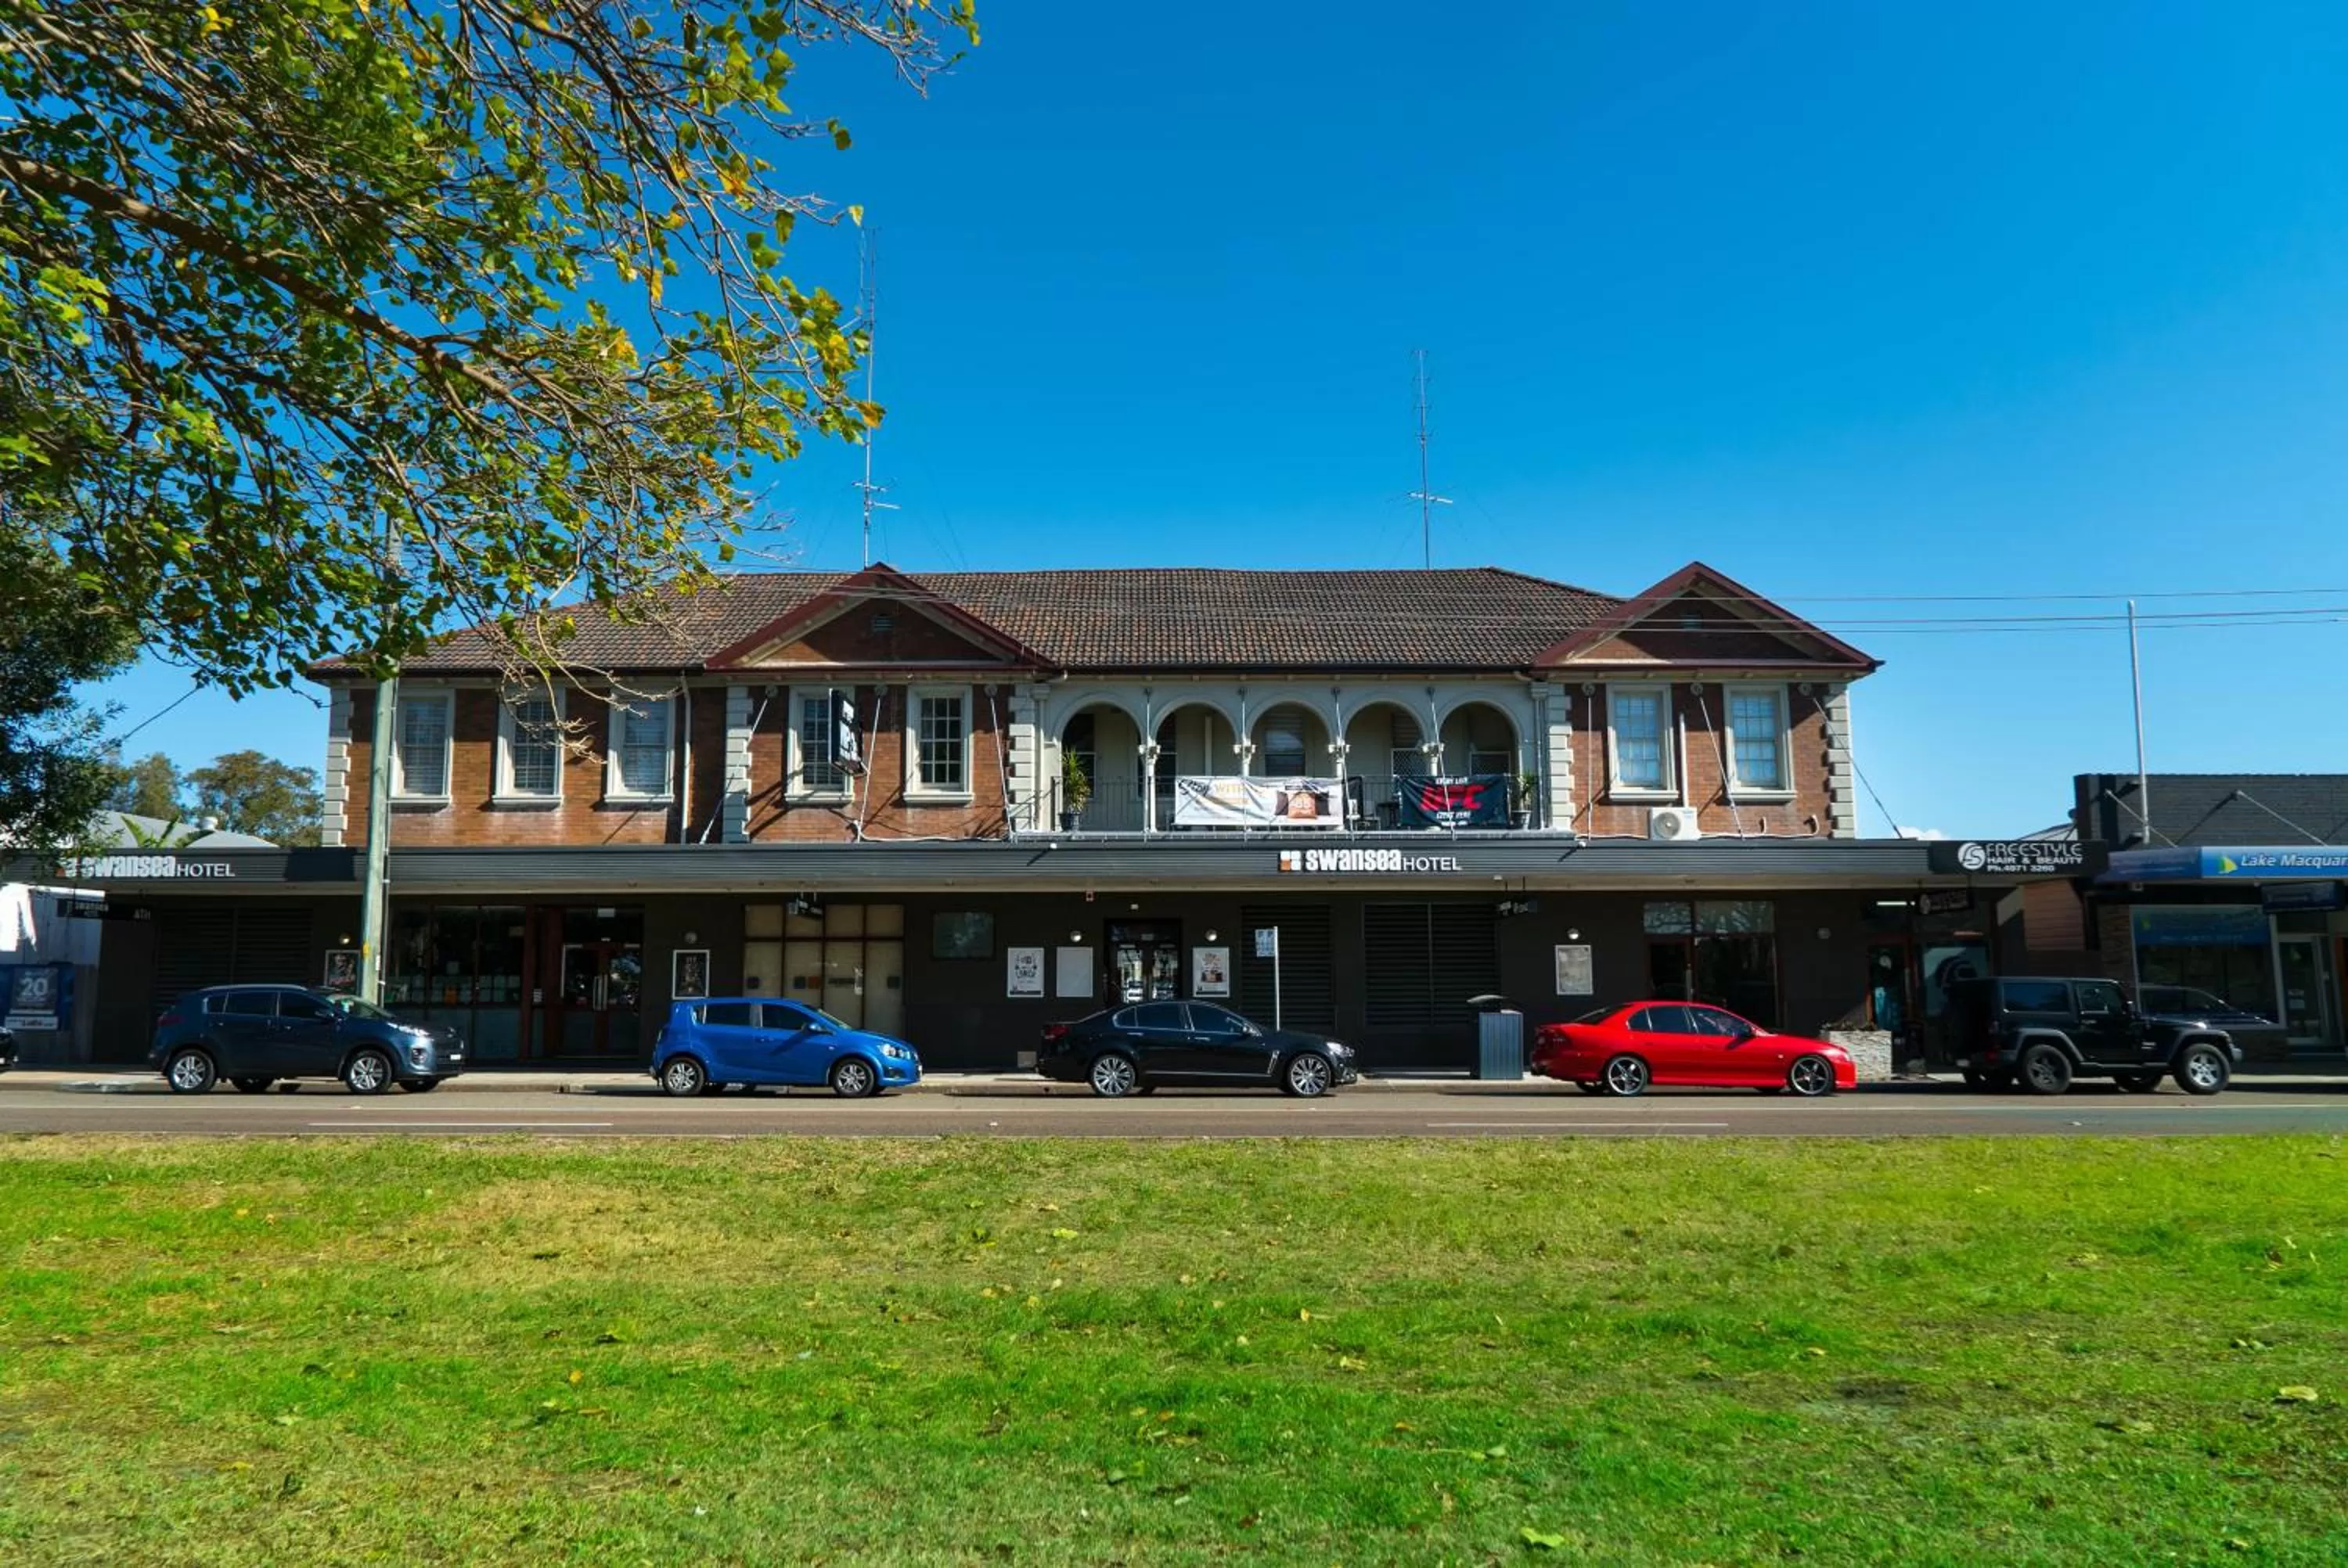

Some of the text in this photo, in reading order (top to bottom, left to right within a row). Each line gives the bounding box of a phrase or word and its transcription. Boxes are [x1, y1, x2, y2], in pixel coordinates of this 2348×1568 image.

[1420, 785, 1486, 811] UFC
[1305, 849, 1463, 871] swansea HOTEL
[1986, 843, 2083, 857] FREESTYLE
[2242, 854, 2276, 866] Lake
[81, 855, 236, 877] swansea HOTEL
